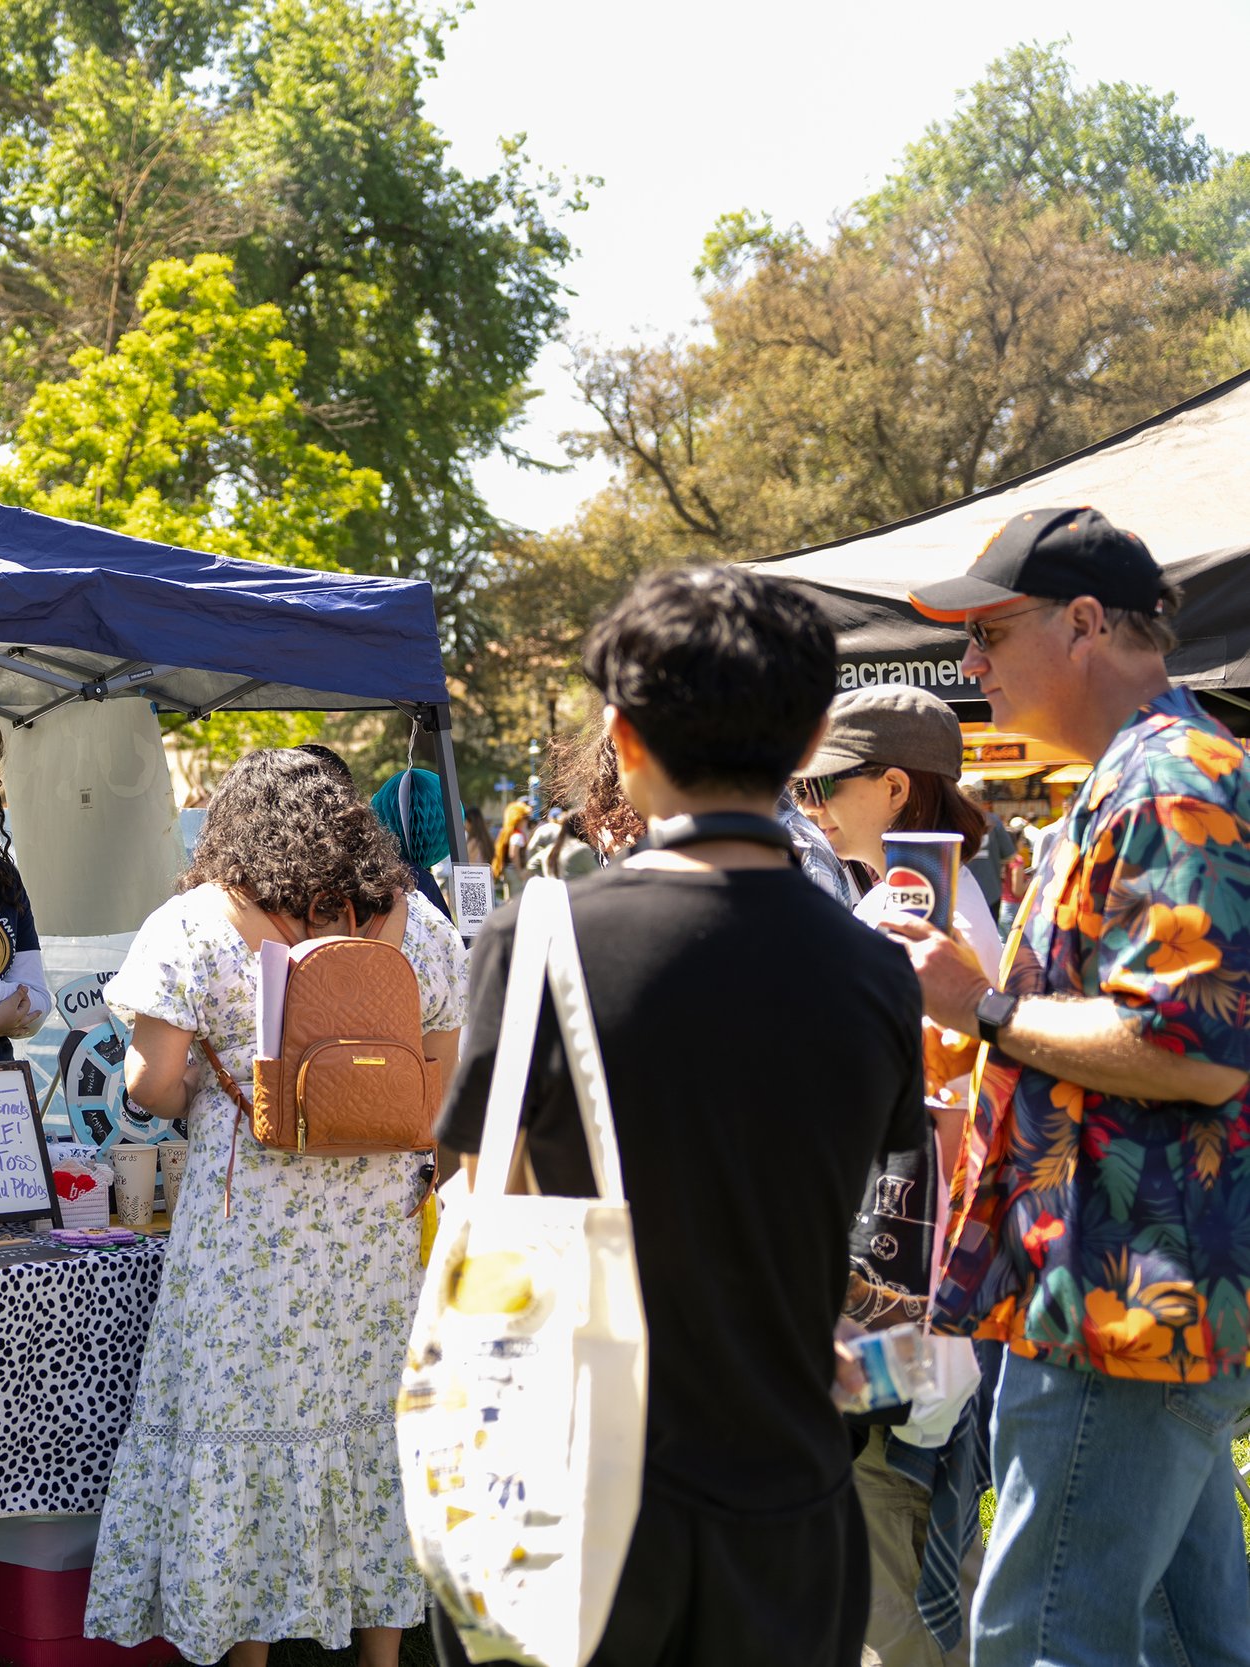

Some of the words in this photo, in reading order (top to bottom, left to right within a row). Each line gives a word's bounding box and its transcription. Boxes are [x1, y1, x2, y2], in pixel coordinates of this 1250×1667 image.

[836, 659, 977, 689] acramen
[888, 892, 929, 906] EPSI
[12, 1176, 49, 1201] Photos
